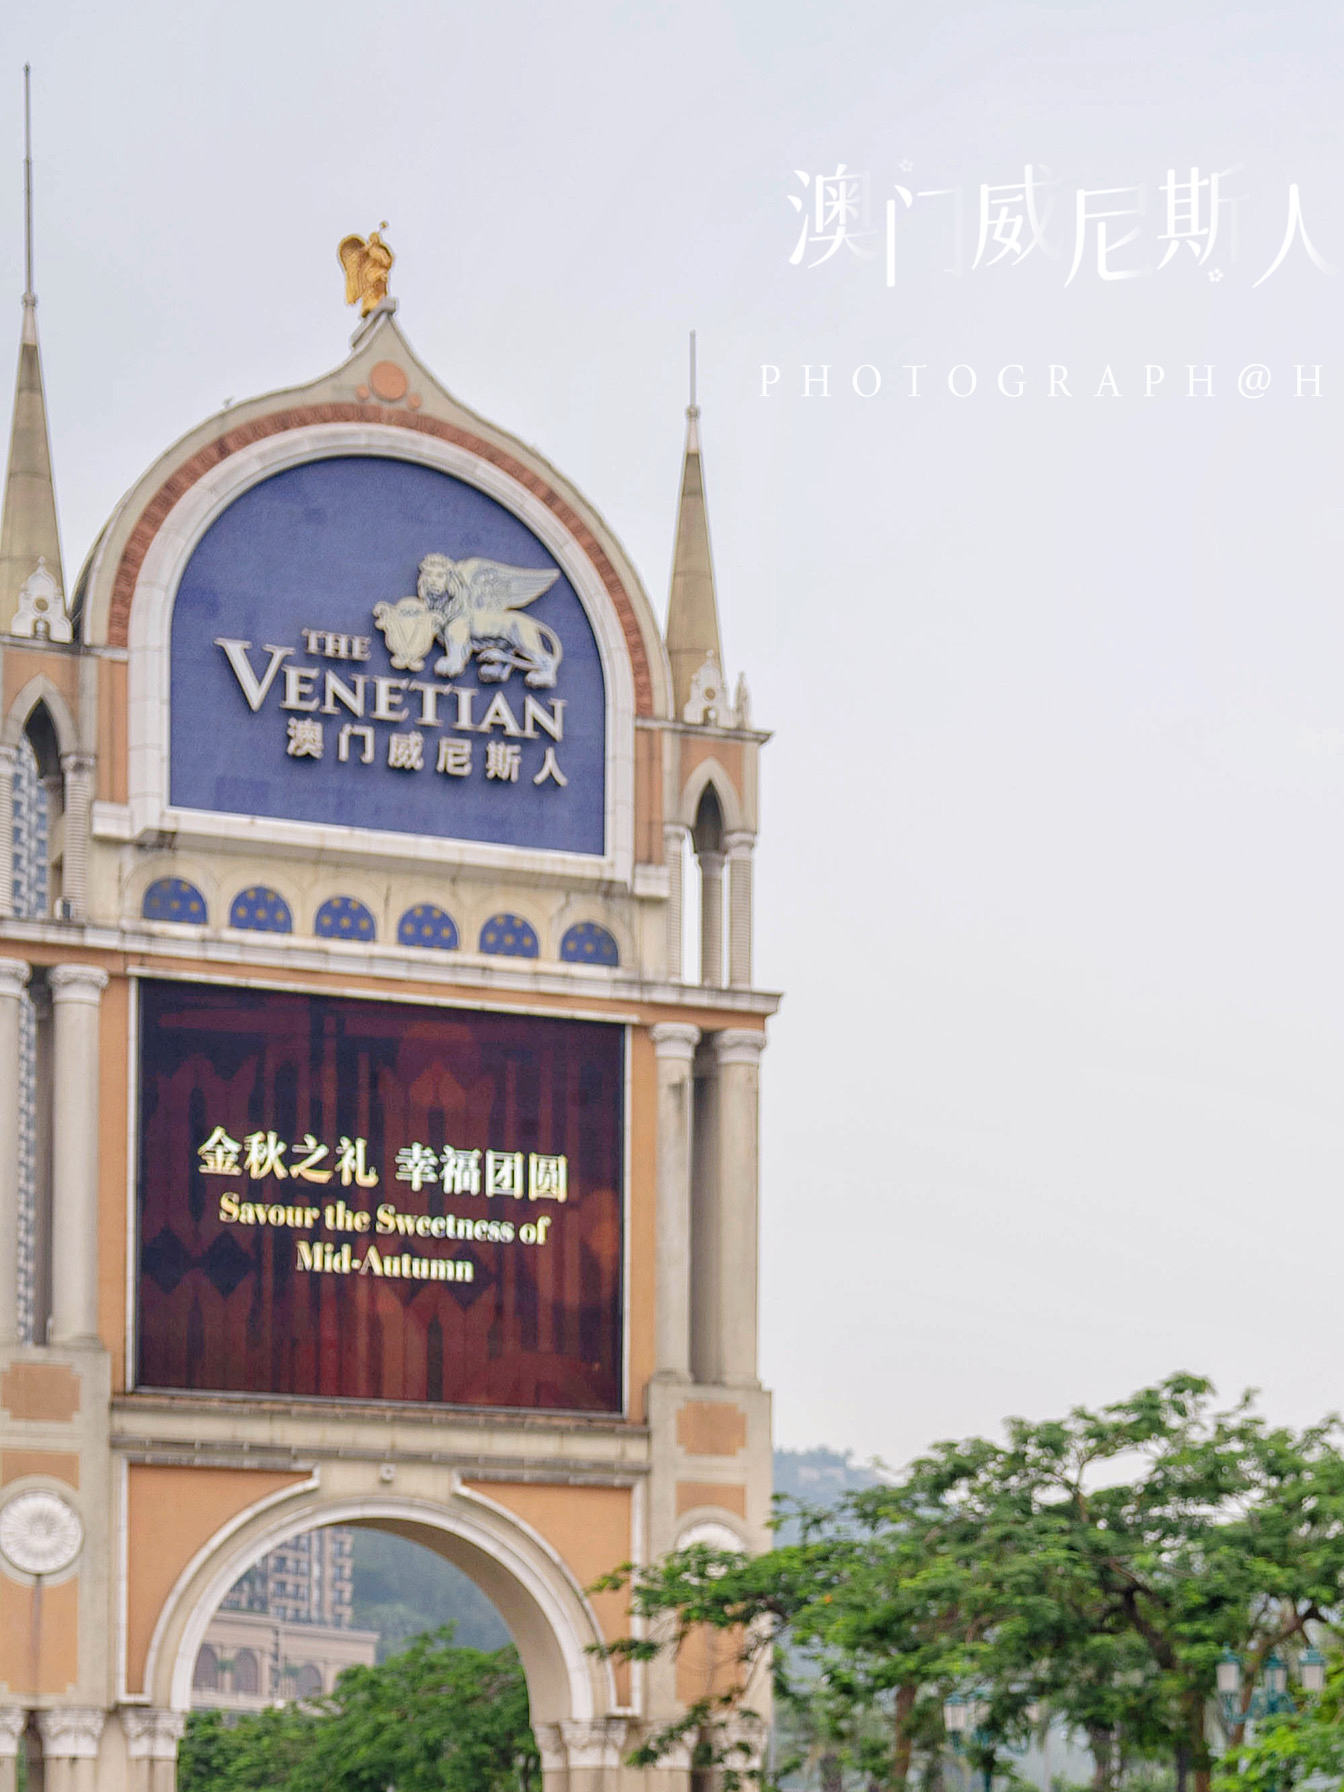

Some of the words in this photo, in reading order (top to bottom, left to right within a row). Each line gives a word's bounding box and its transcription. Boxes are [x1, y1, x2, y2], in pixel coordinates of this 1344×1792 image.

[302, 628, 371, 662] THE
[213, 637, 568, 743] VENETIAN
[286, 716, 569, 787] 澳门威尼斯人
[197, 1125, 379, 1188] 金秋之礼
[395, 1141, 568, 1203] 幸福团圆
[219, 1192, 320, 1230] Savour
[324, 1200, 370, 1233] the
[376, 1204, 515, 1244] Sweetness
[519, 1216, 552, 1246] of
[295, 1240, 475, 1283] Mid-Autumn
